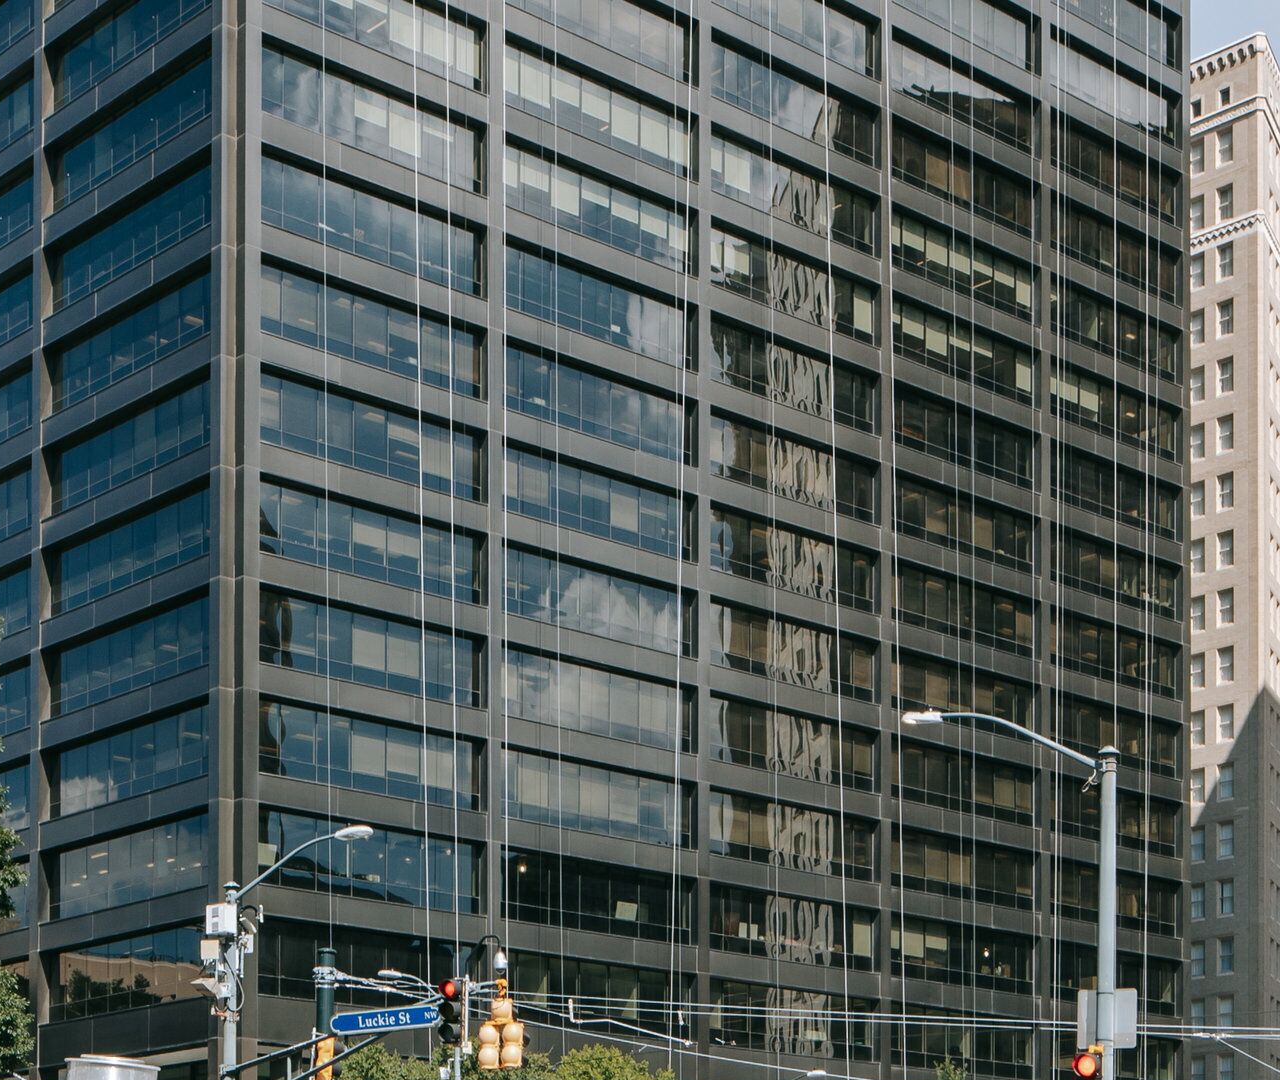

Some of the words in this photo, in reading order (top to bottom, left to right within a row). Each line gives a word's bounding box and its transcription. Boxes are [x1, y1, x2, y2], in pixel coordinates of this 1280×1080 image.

[358, 1014, 395, 1028] Luckie
[398, 1011, 411, 1024] St
[424, 1010, 438, 1020] NW
